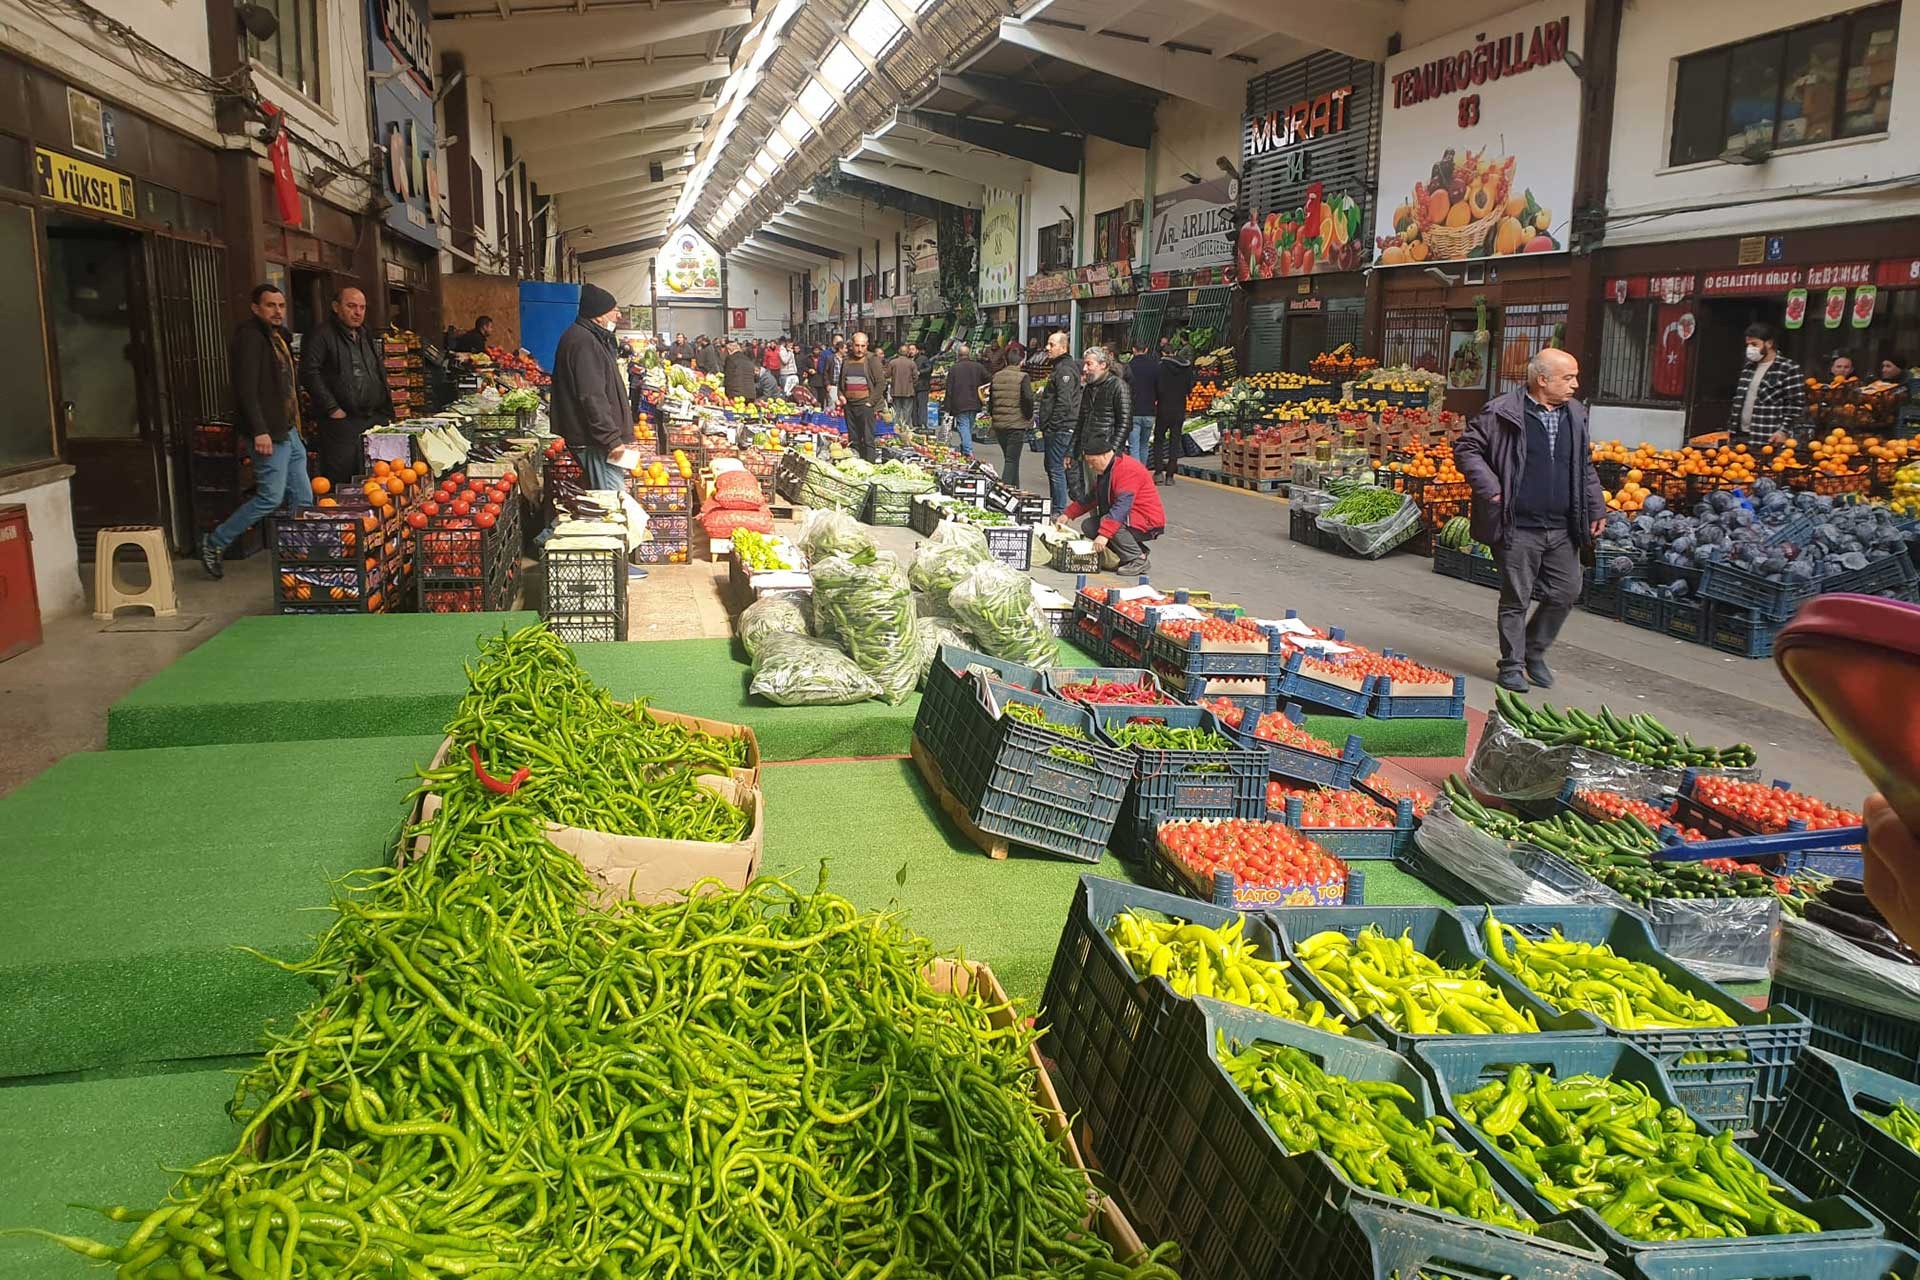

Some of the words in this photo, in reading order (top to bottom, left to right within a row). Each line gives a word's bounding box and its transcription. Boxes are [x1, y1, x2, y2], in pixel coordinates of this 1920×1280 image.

[1392, 16, 1570, 109] TEMUROĞULLARI
[1251, 85, 1353, 155] MURAT
[1458, 94, 1481, 128] 83
[58, 163, 118, 211] YÜKSEL
